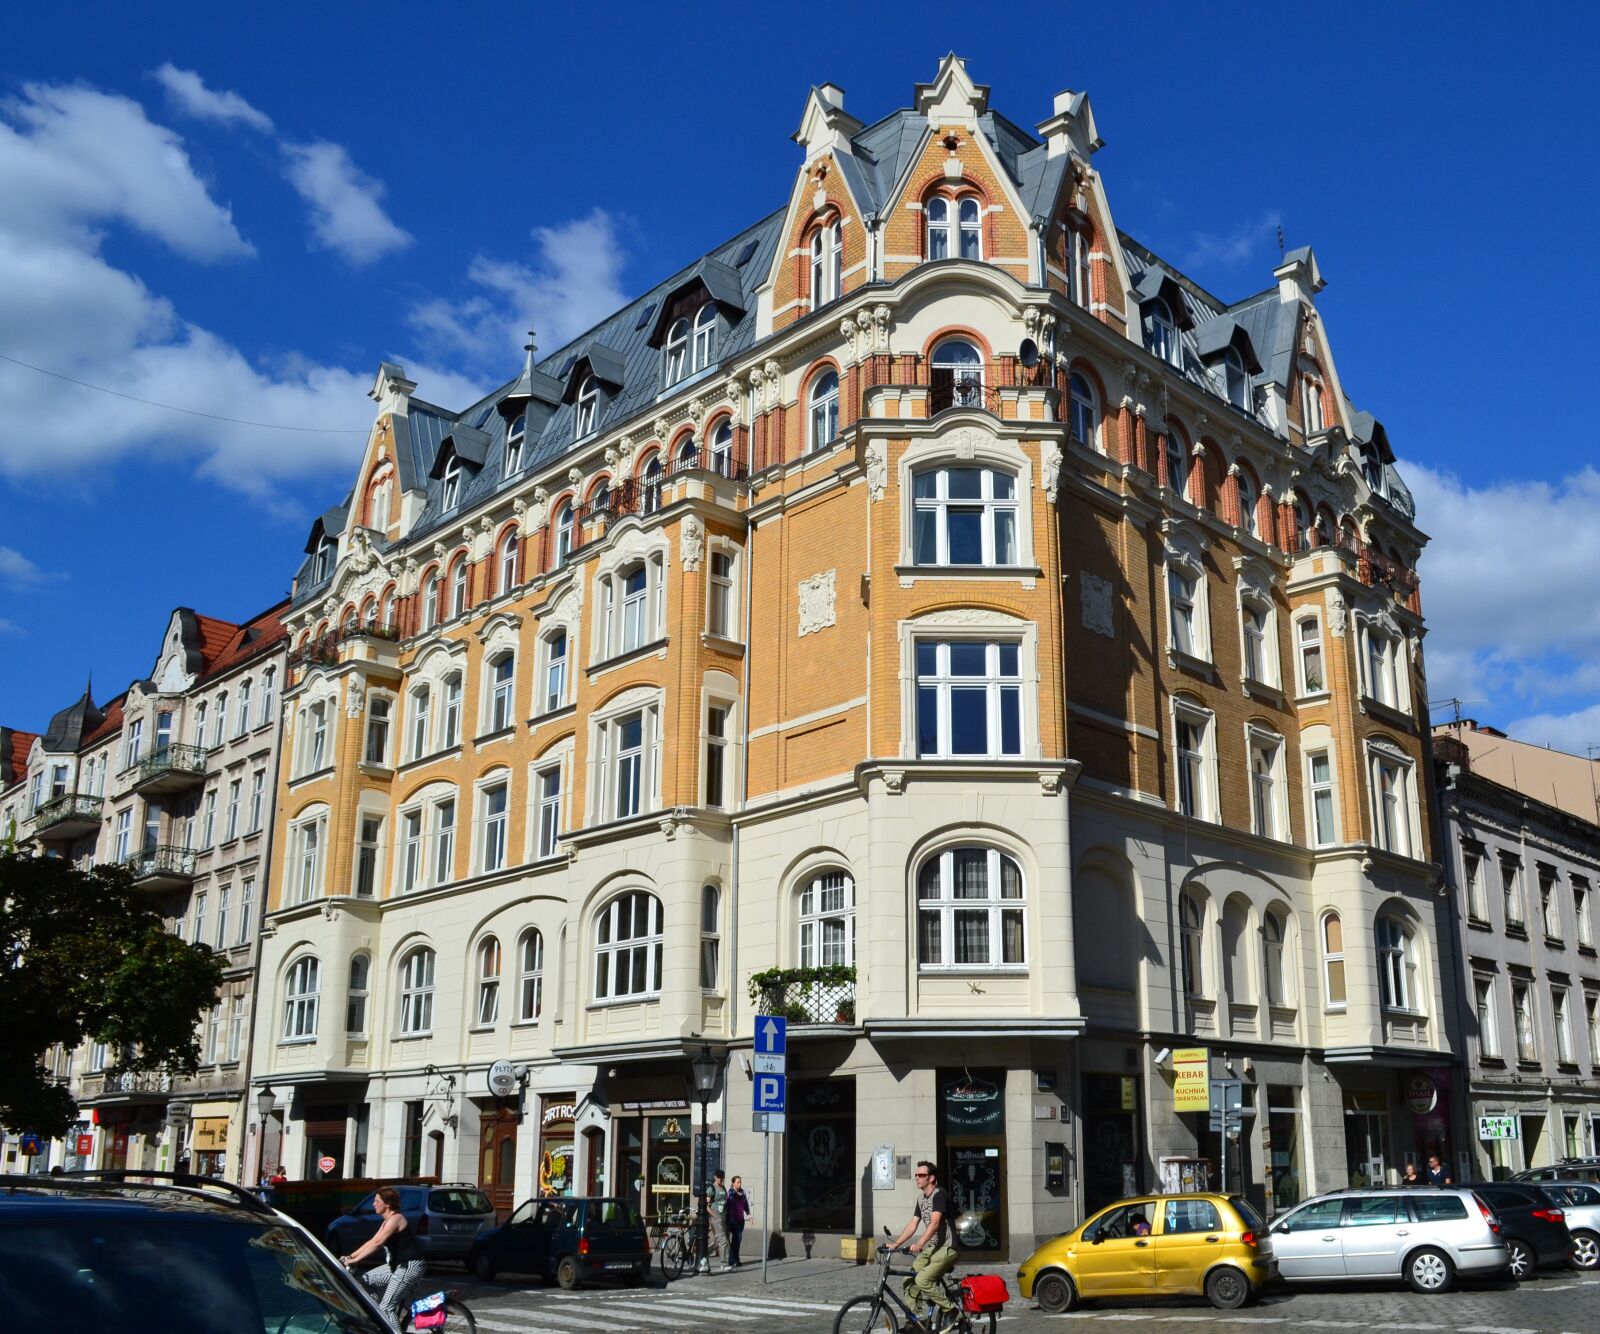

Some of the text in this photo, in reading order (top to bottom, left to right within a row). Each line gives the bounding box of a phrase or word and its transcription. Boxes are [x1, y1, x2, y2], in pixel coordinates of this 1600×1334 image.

[1176, 1071, 1203, 1079] KEBAB
[761, 1078, 778, 1107] P
[986, 1112, 998, 1121] BAR
